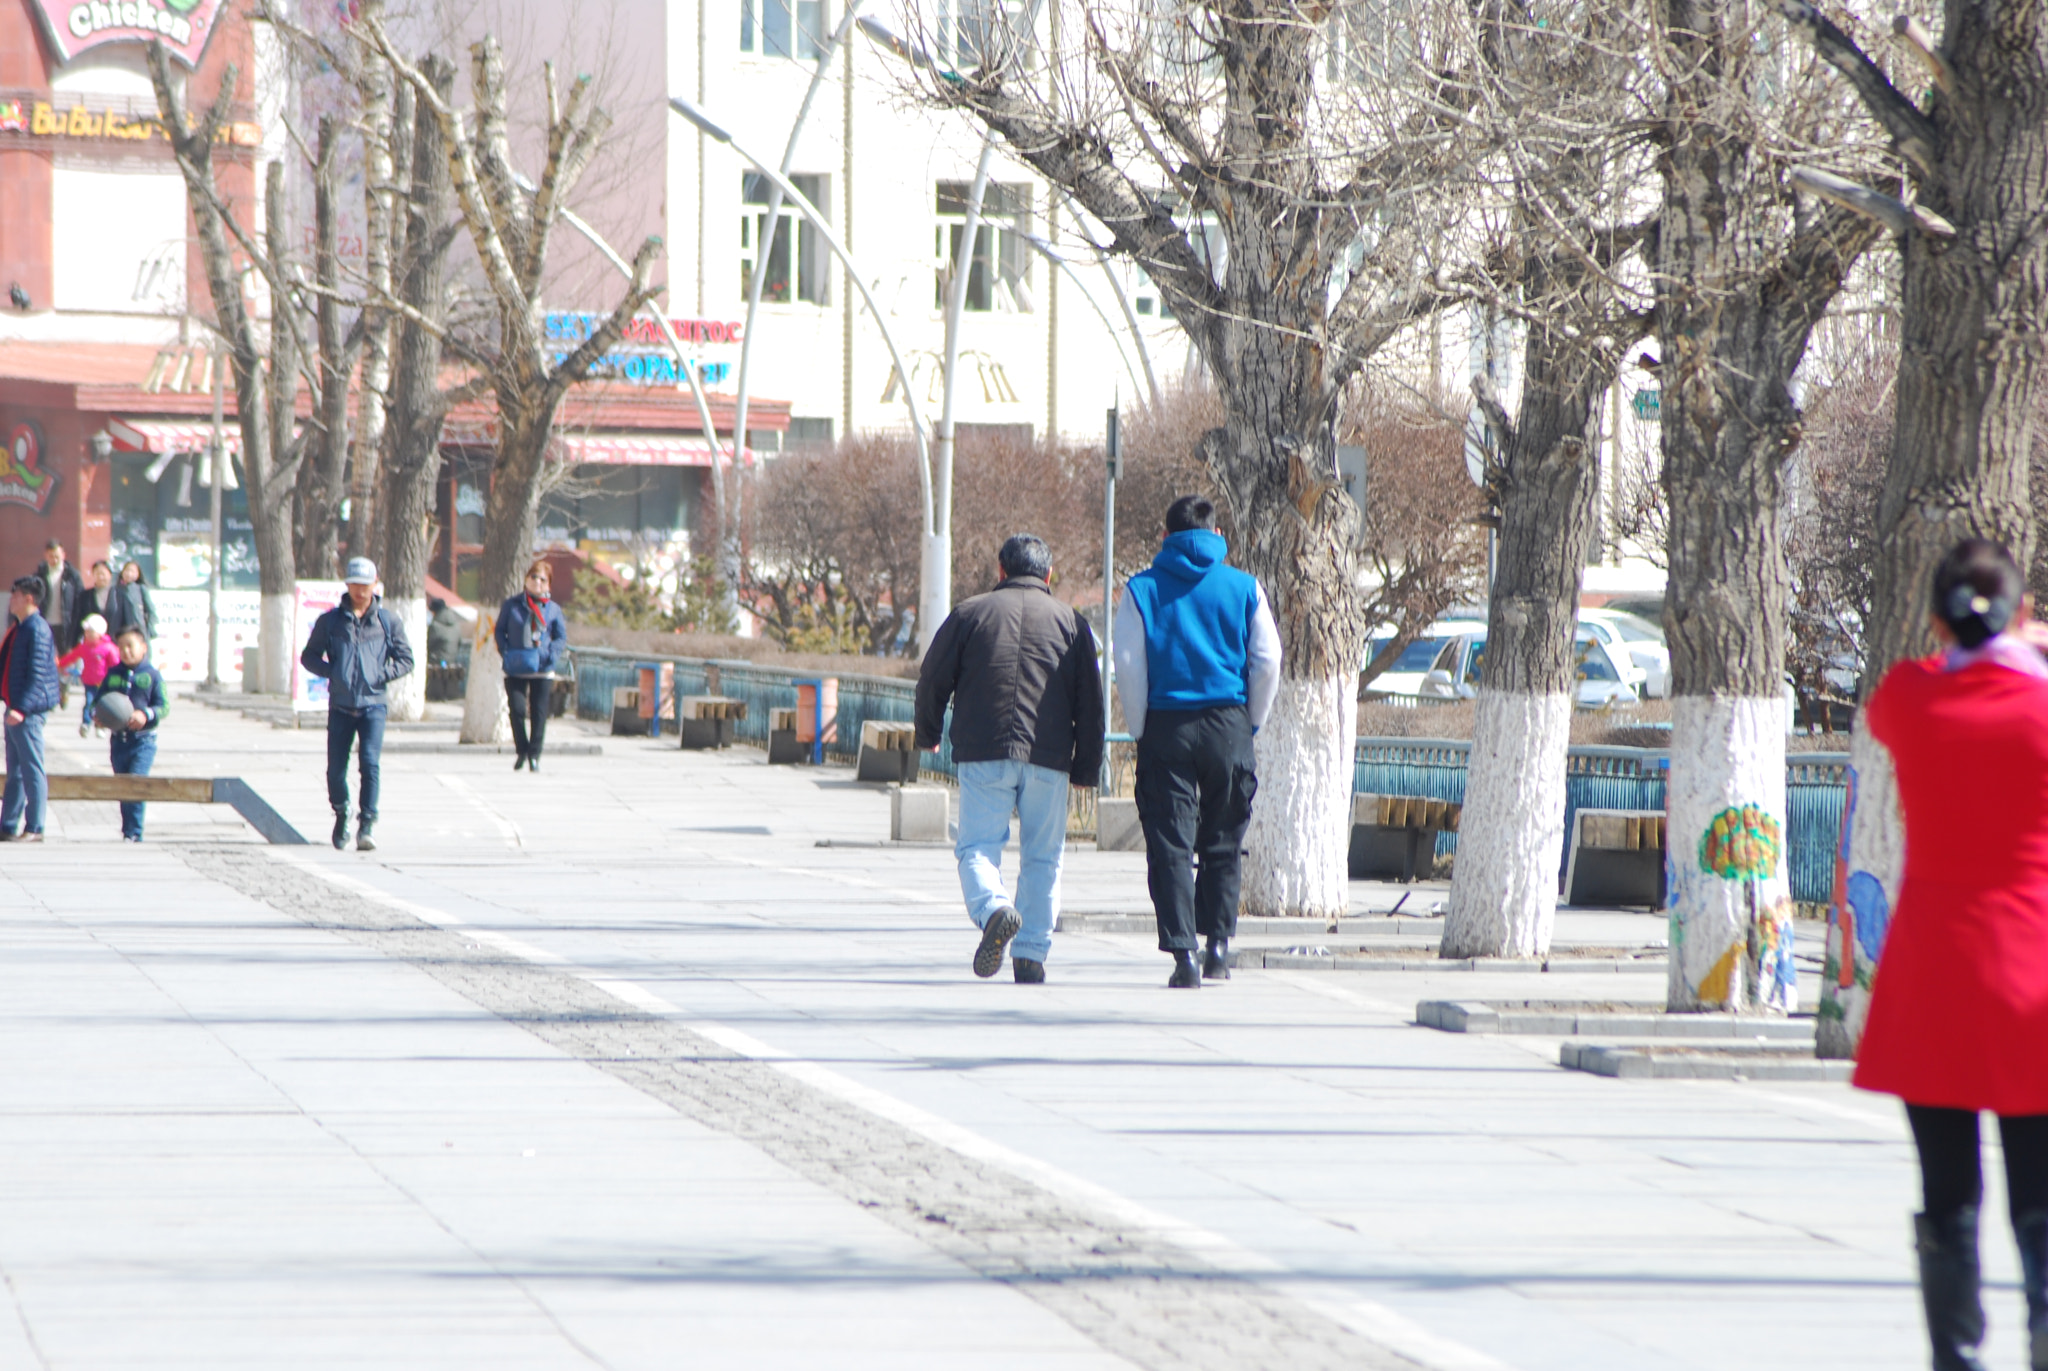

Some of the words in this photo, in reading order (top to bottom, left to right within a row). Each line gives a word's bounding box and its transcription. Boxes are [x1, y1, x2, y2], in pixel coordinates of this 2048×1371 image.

[69, 0, 191, 46] Chicken
[303, 226, 363, 257] Pza
[622, 317, 745, 344] ОЛОНГОС
